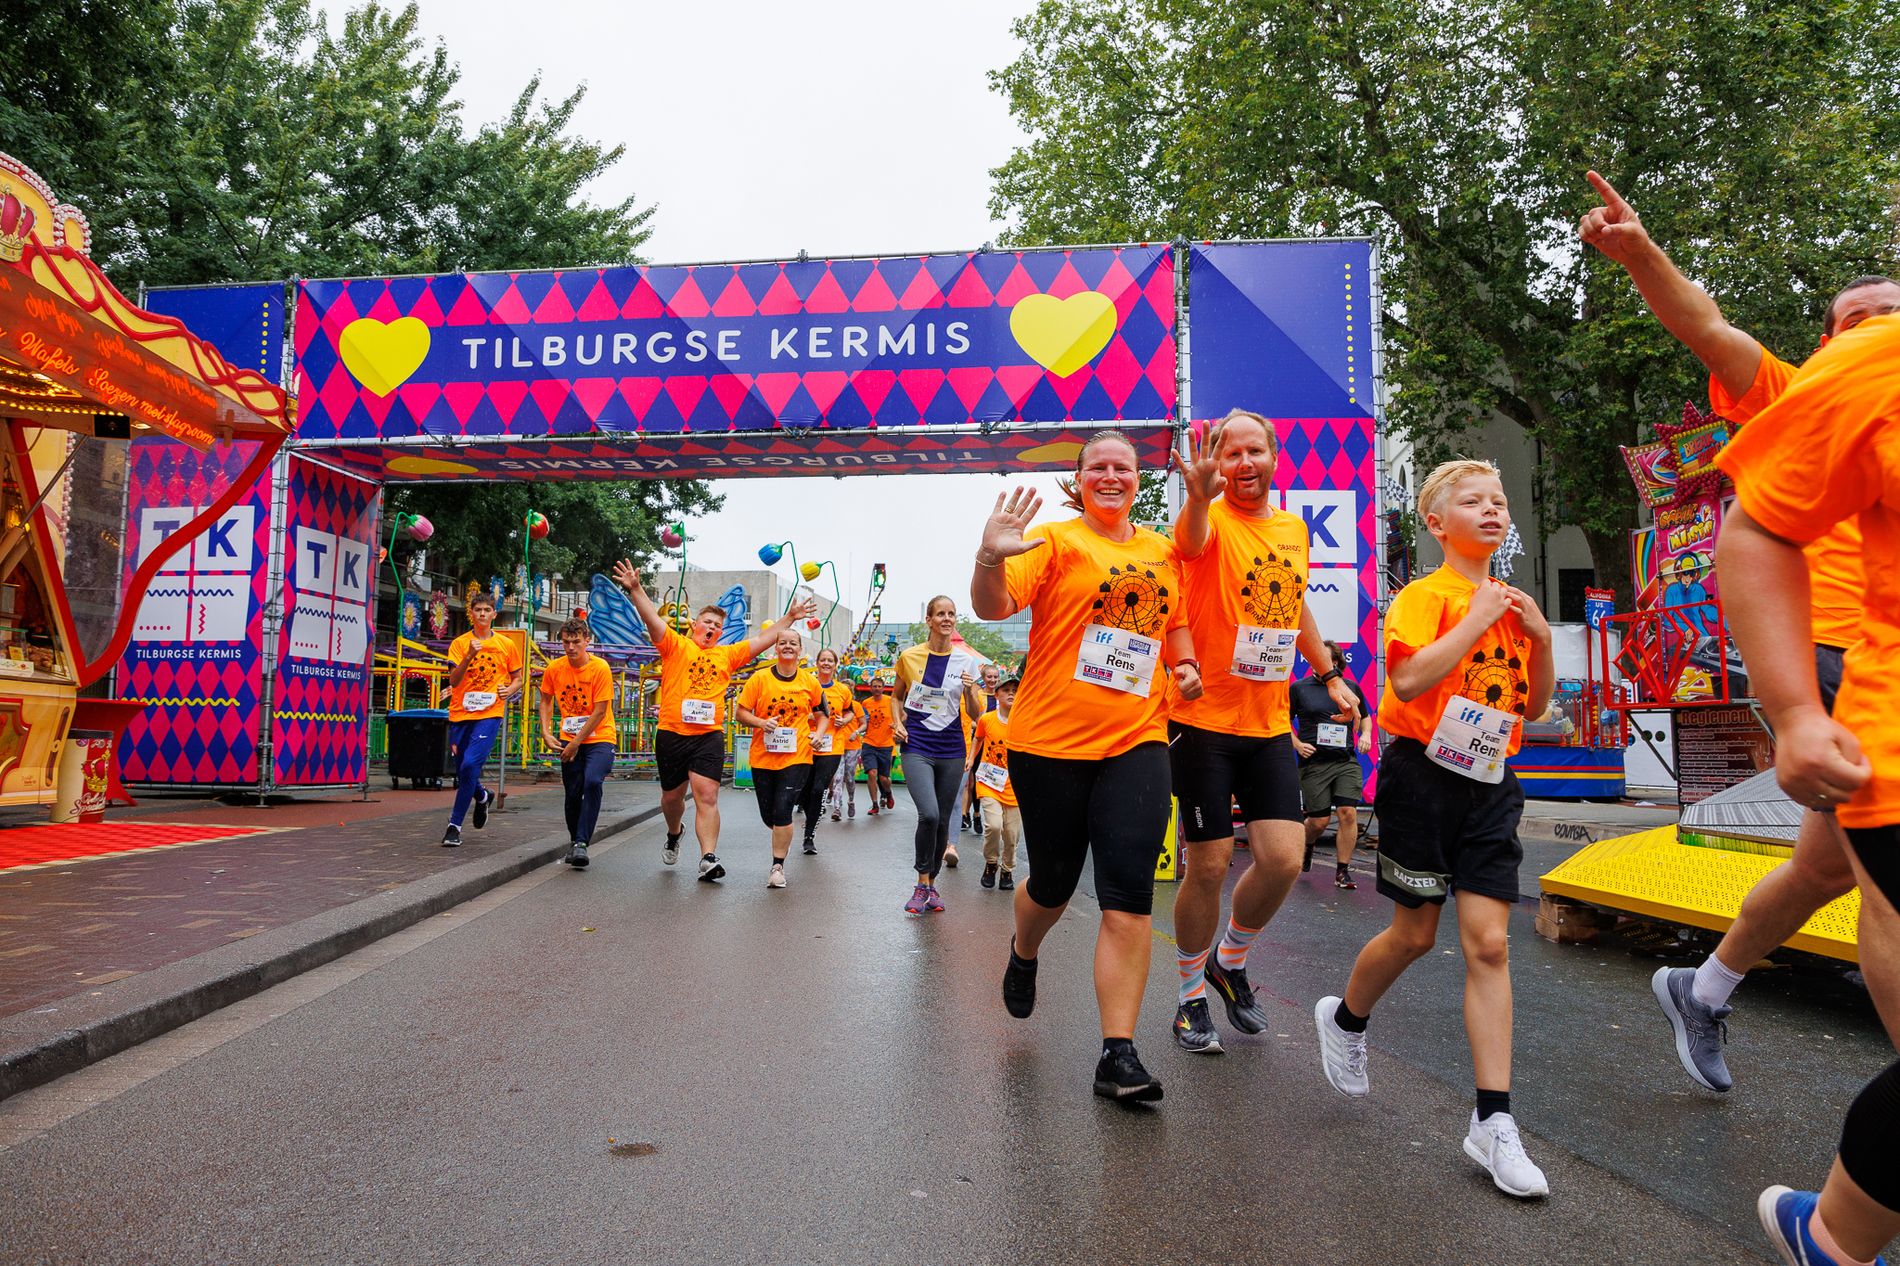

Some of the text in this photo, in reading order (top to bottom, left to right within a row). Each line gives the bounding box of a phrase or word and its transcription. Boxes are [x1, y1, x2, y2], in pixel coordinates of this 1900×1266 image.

[462, 321, 971, 369] TILBURGSE KERMIS
[20, 332, 80, 375] Wafels
[88, 368, 139, 406] Soezen
[164, 410, 216, 445] slagroom
[498, 451, 982, 470] TILBURGSE KERMIS
[1095, 631, 1114, 644] iff
[1249, 631, 1264, 643] iff
[136, 649, 242, 659] TILBURGSE KERMIS
[1114, 648, 1132, 659] Team
[1259, 652, 1283, 663] Rens
[1106, 654, 1136, 672] Rens
[291, 664, 361, 680] TILBURGSE KERMIS
[1460, 707, 1484, 725] iff
[1681, 710, 1754, 726] Reglement
[1481, 731, 1500, 744] Team
